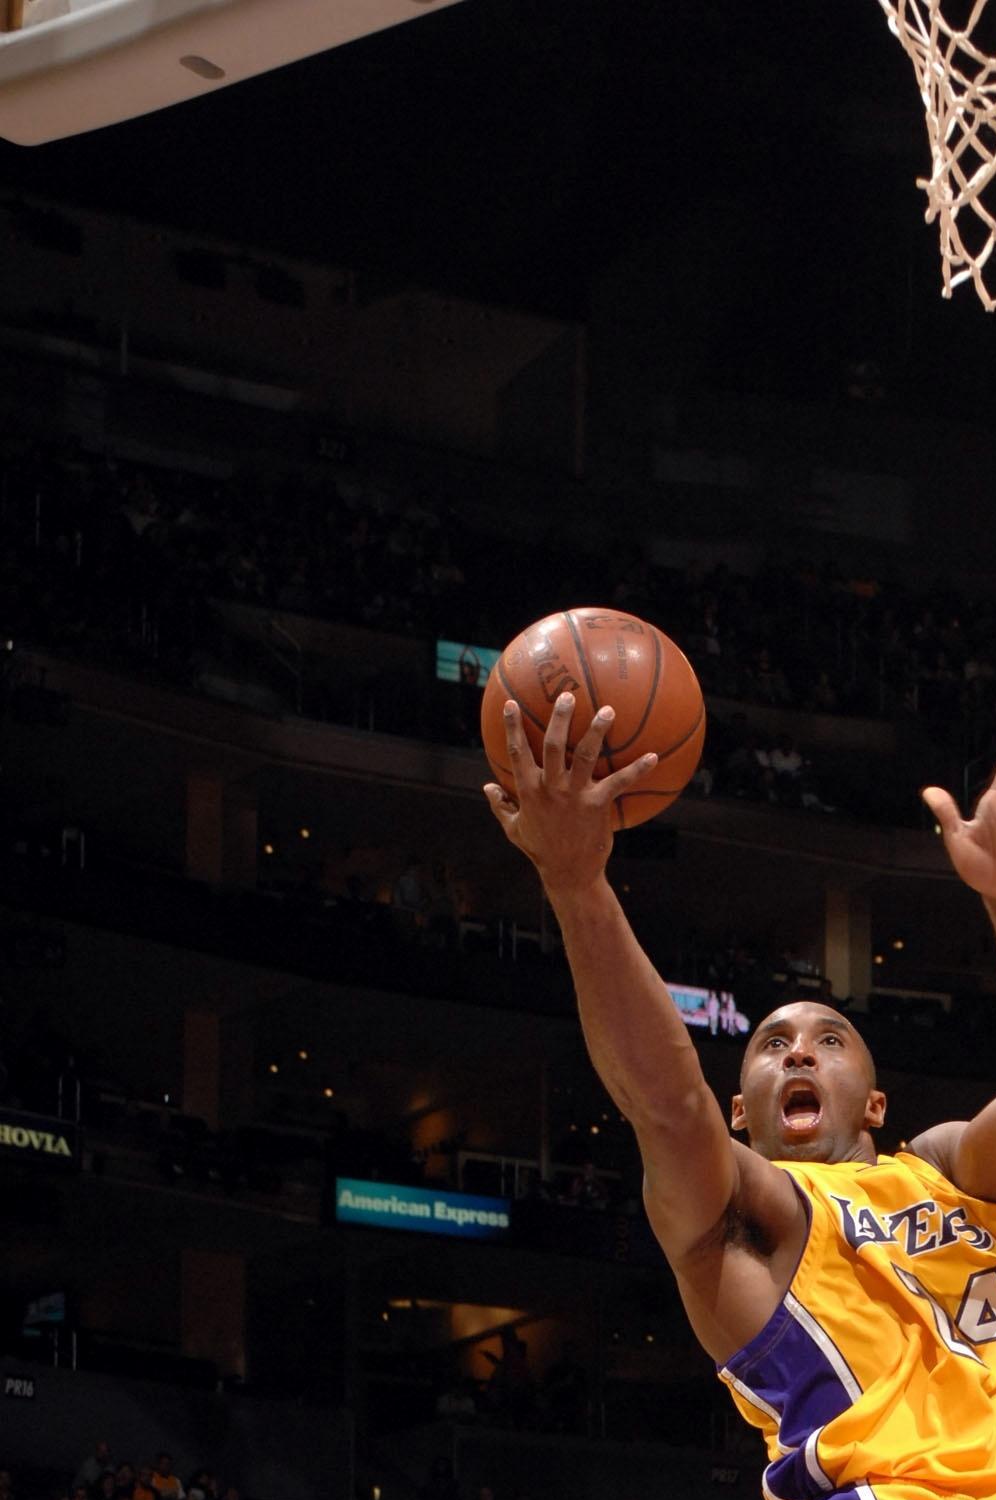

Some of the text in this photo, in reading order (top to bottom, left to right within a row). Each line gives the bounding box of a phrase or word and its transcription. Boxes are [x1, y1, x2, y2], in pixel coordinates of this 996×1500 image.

[338, 1189, 509, 1228] American Express
[4, 1377, 34, 1398] PR16
